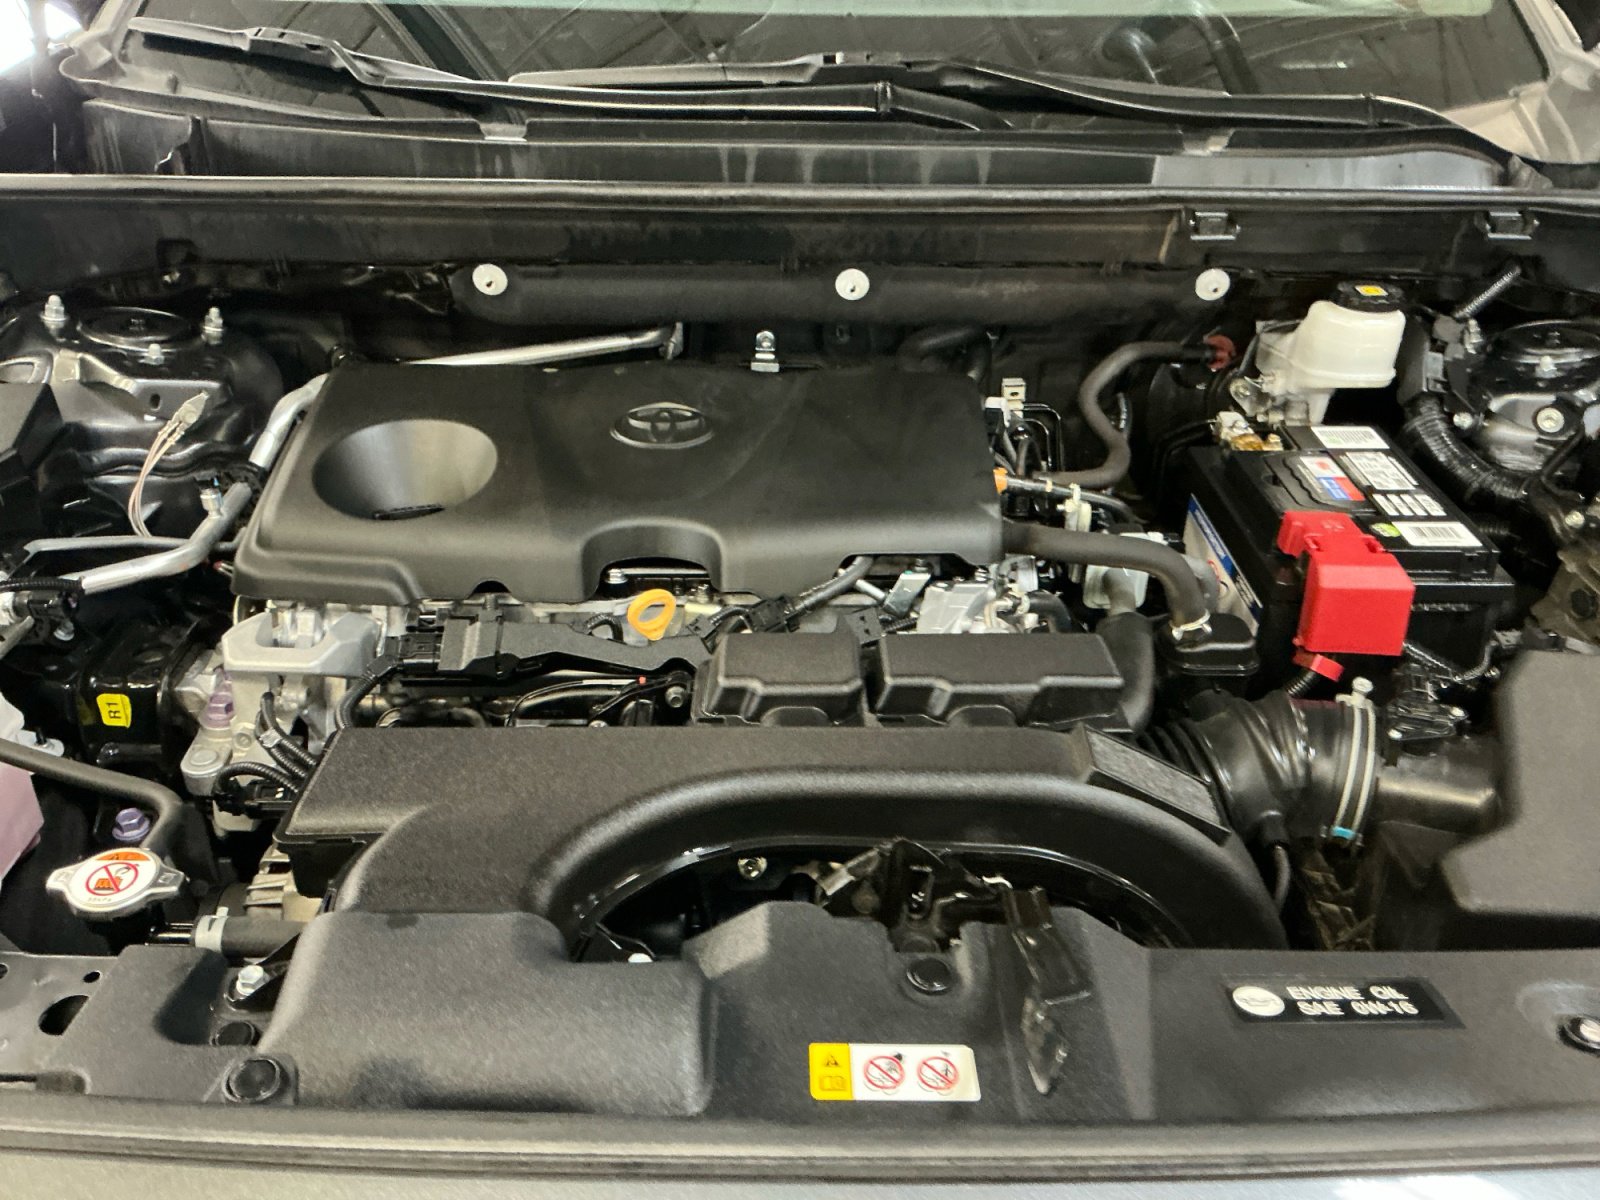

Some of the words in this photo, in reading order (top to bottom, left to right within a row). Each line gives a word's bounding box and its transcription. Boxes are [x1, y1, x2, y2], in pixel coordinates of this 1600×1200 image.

[106, 702, 121, 719] R1
[1286, 986, 1365, 1000] ENGINE
[1369, 985, 1409, 1000] OIL
[1297, 1001, 1345, 1015] SAE
